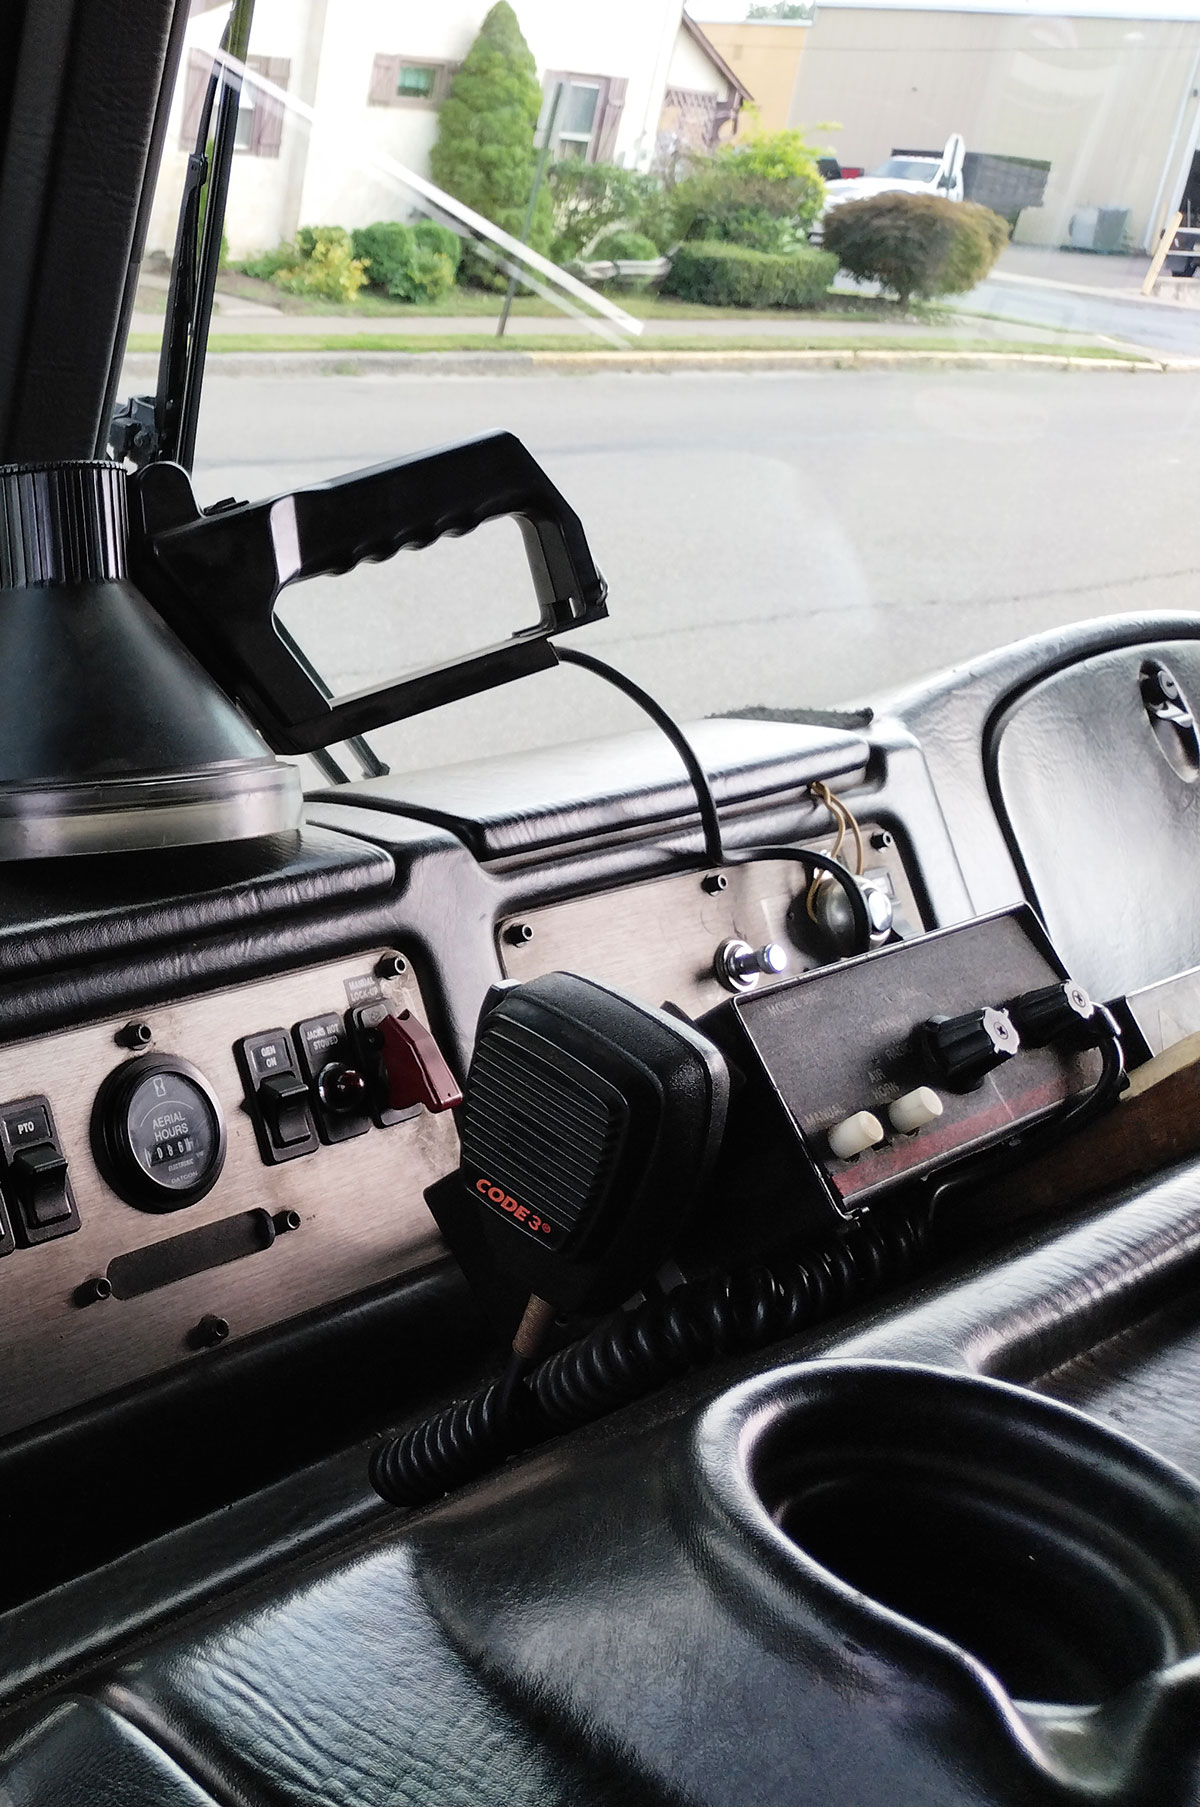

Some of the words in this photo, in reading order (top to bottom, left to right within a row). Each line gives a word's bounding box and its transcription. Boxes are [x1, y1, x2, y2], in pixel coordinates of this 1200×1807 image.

[326, 1022, 339, 1035] NOT
[313, 1035, 339, 1051] STOWED
[265, 1056, 278, 1068] ON
[17, 1120, 35, 1135] PTO
[152, 1111, 186, 1130] AERIAL
[154, 1122, 189, 1142] HOURS
[475, 1178, 531, 1222] CODE
